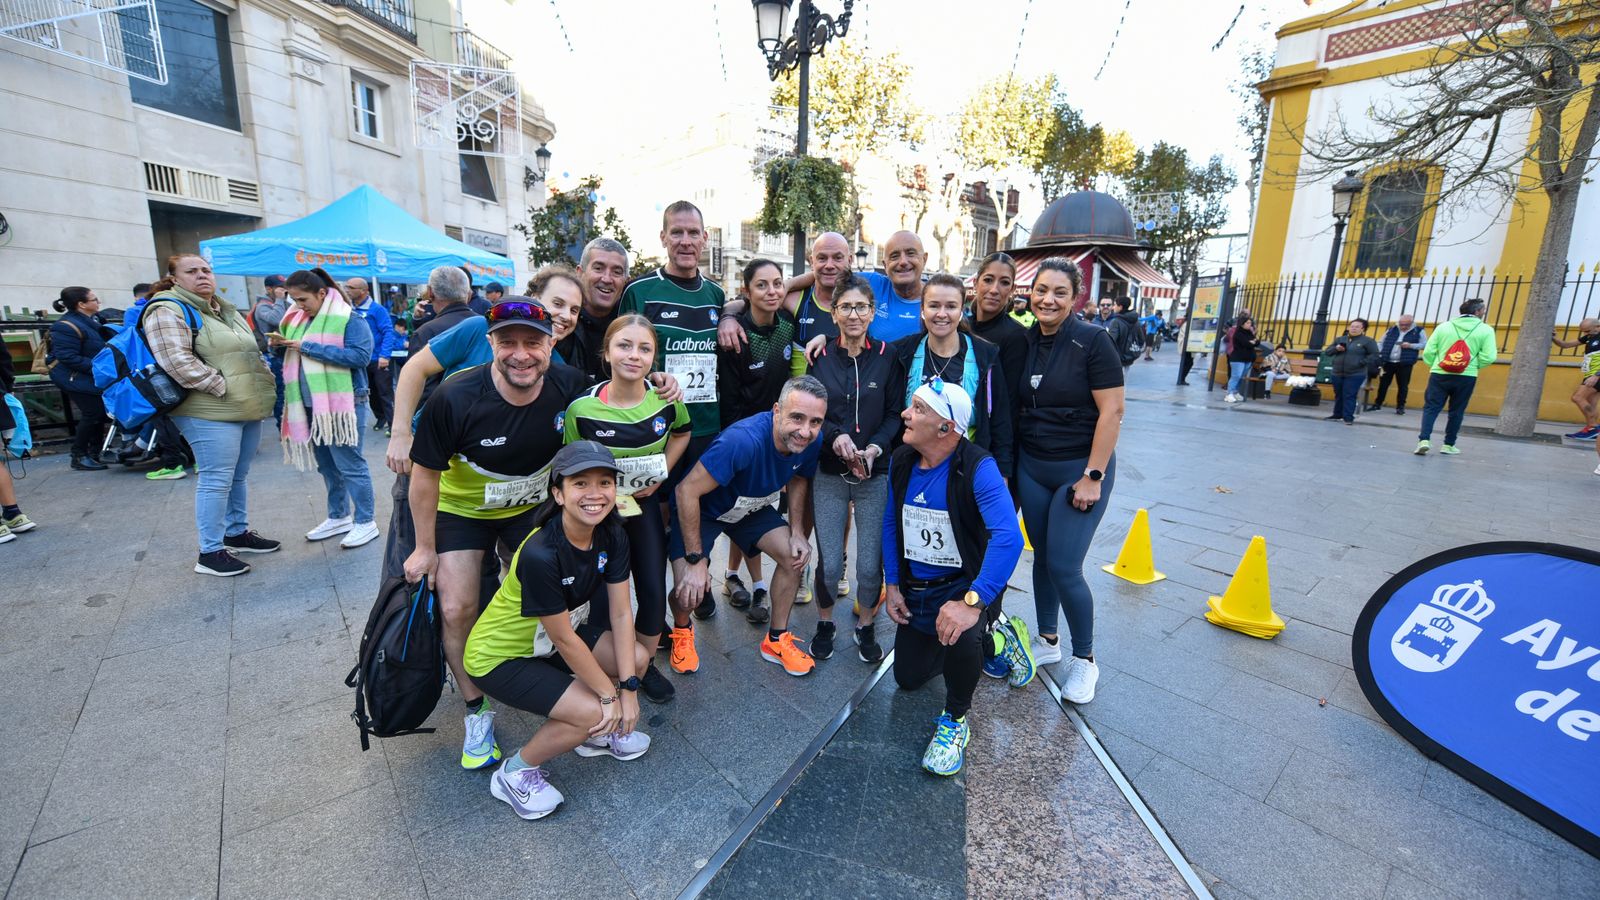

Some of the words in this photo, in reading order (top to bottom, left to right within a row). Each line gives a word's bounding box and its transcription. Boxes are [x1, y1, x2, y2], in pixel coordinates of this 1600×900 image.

[665, 337, 717, 351] Ladbroke
[686, 372, 705, 389] 22
[616, 475, 659, 489] 166
[504, 489, 542, 507] 165
[920, 528, 945, 551] 93
[1514, 687, 1600, 742] de
